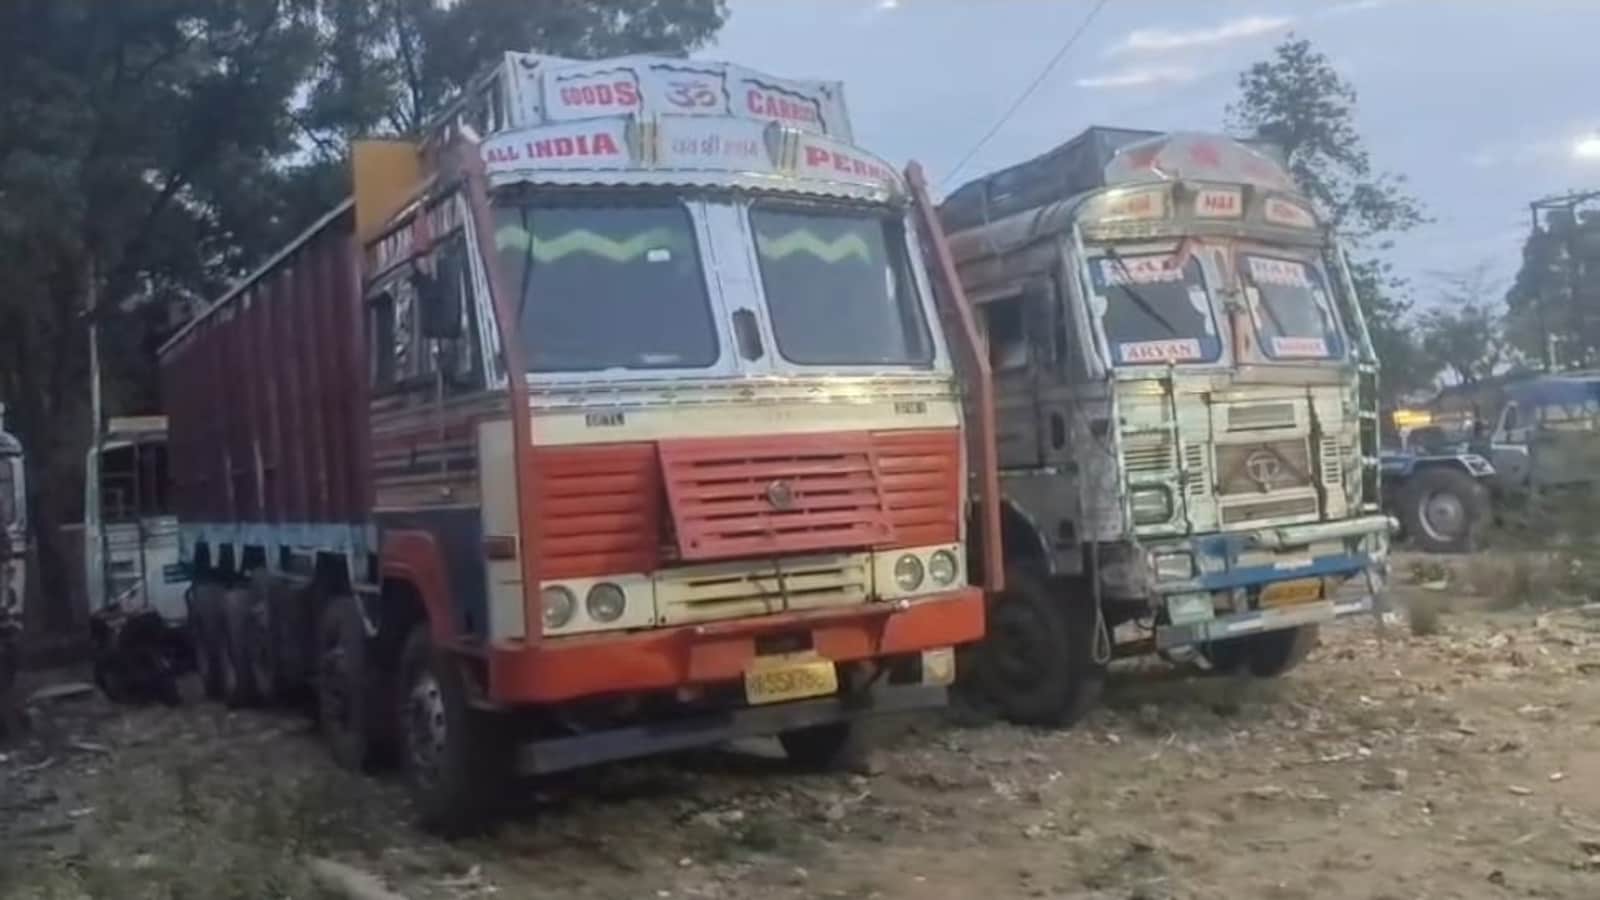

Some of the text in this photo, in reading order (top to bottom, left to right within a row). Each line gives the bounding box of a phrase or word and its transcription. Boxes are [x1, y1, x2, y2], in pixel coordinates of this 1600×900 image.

[560, 81, 638, 107] GOODS
[487, 132, 619, 162] ALL INDIA
[1126, 344, 1192, 363] ARYAN
